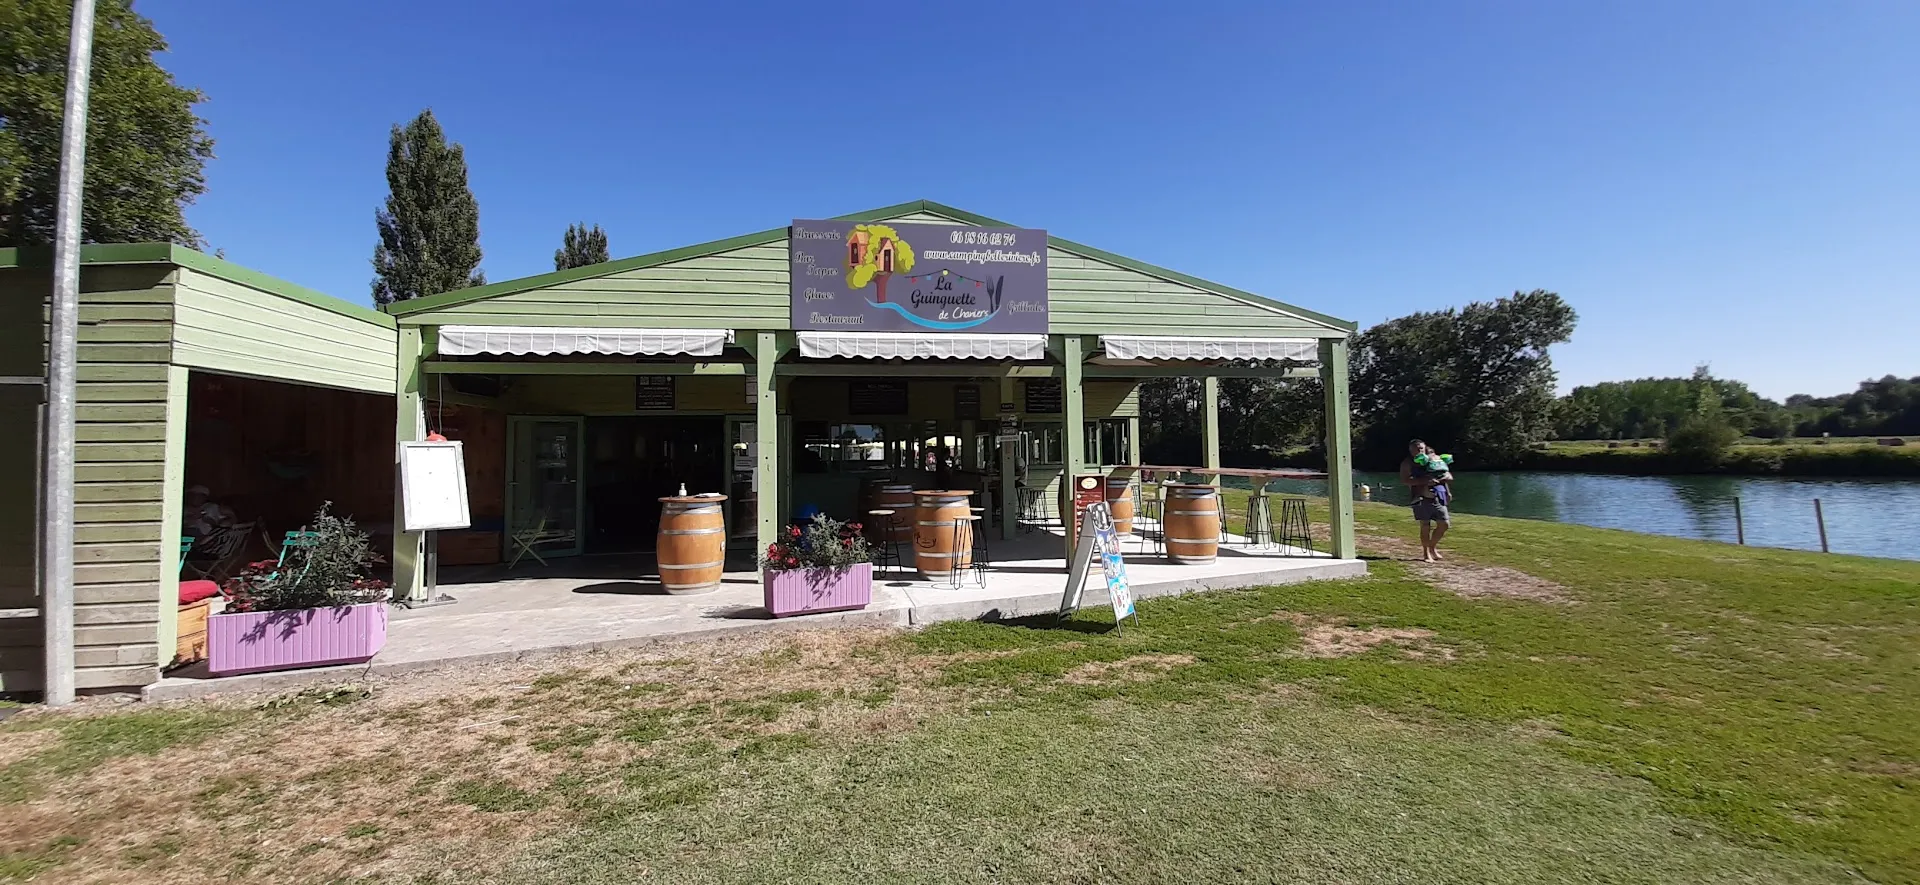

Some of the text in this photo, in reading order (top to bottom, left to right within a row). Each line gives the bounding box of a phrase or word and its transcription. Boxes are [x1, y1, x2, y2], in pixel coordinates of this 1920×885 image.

[795, 227, 841, 240] Brasserie
[950, 231, 1016, 246] 06 18 16 62 74
[923, 249, 1041, 266] www.campingbelleriviere.fr
[806, 264, 839, 279] Tapas
[934, 276, 952, 291] La
[803, 287, 834, 302] Glaces
[911, 289, 976, 309] Guinguette
[938, 307, 989, 320] de Chaniers
[1007, 300, 1046, 315] Grillades
[810, 312, 864, 324] Restaurant
